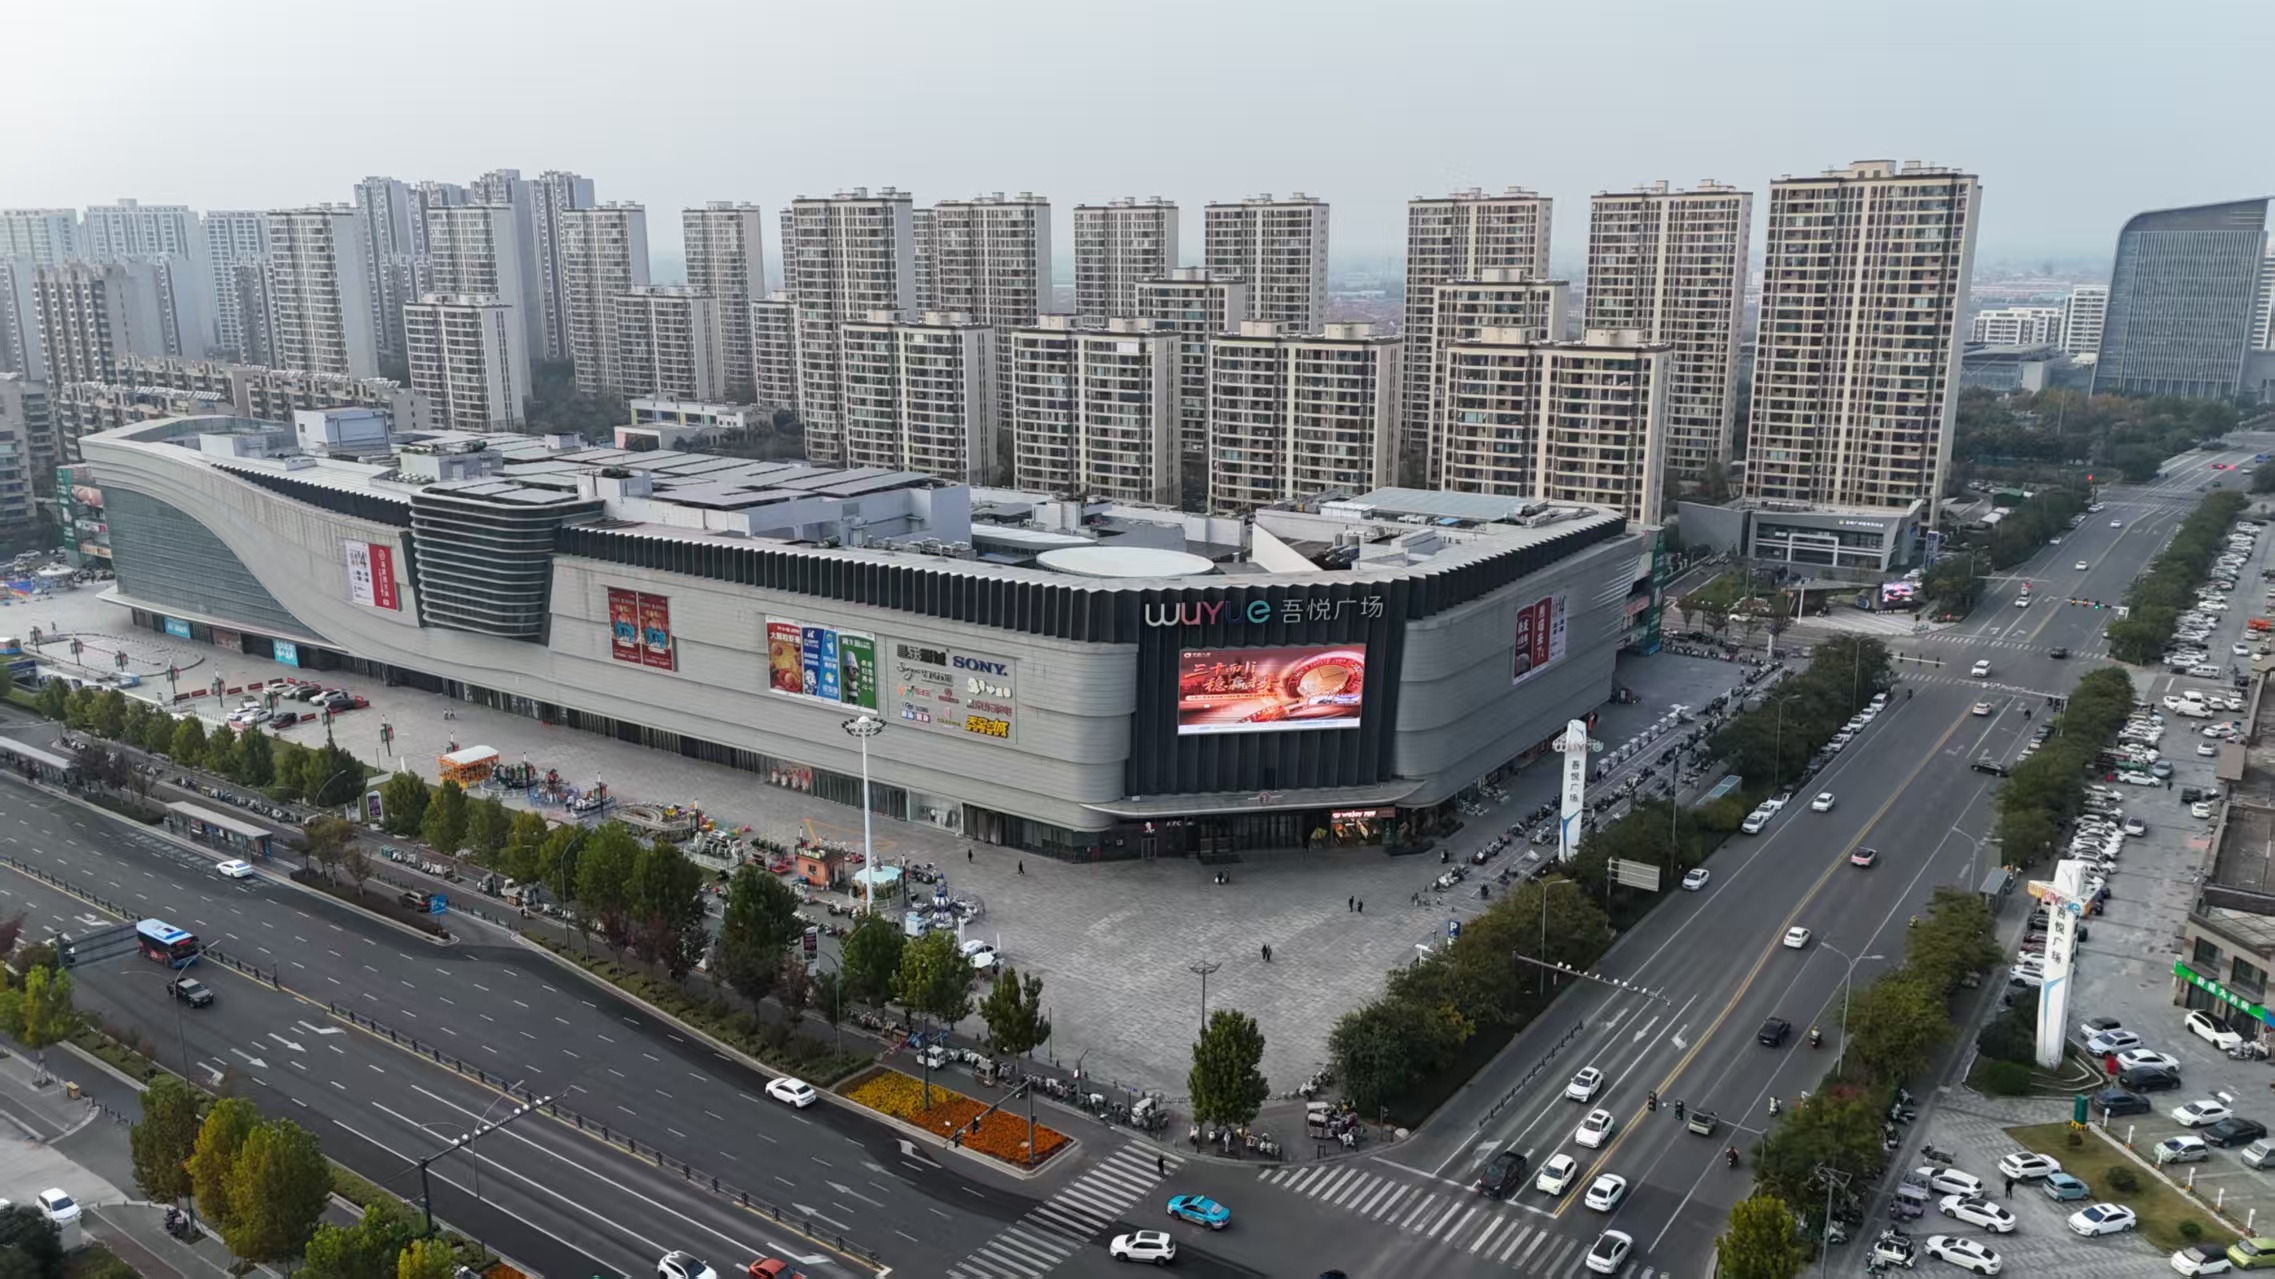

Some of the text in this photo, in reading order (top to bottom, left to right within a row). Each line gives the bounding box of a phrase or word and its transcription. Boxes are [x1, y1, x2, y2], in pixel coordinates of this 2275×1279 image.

[1280, 595, 1384, 623] 吾悦广场
[1569, 760, 1580, 802] 吾悦广场
[1450, 921, 1458, 931] P
